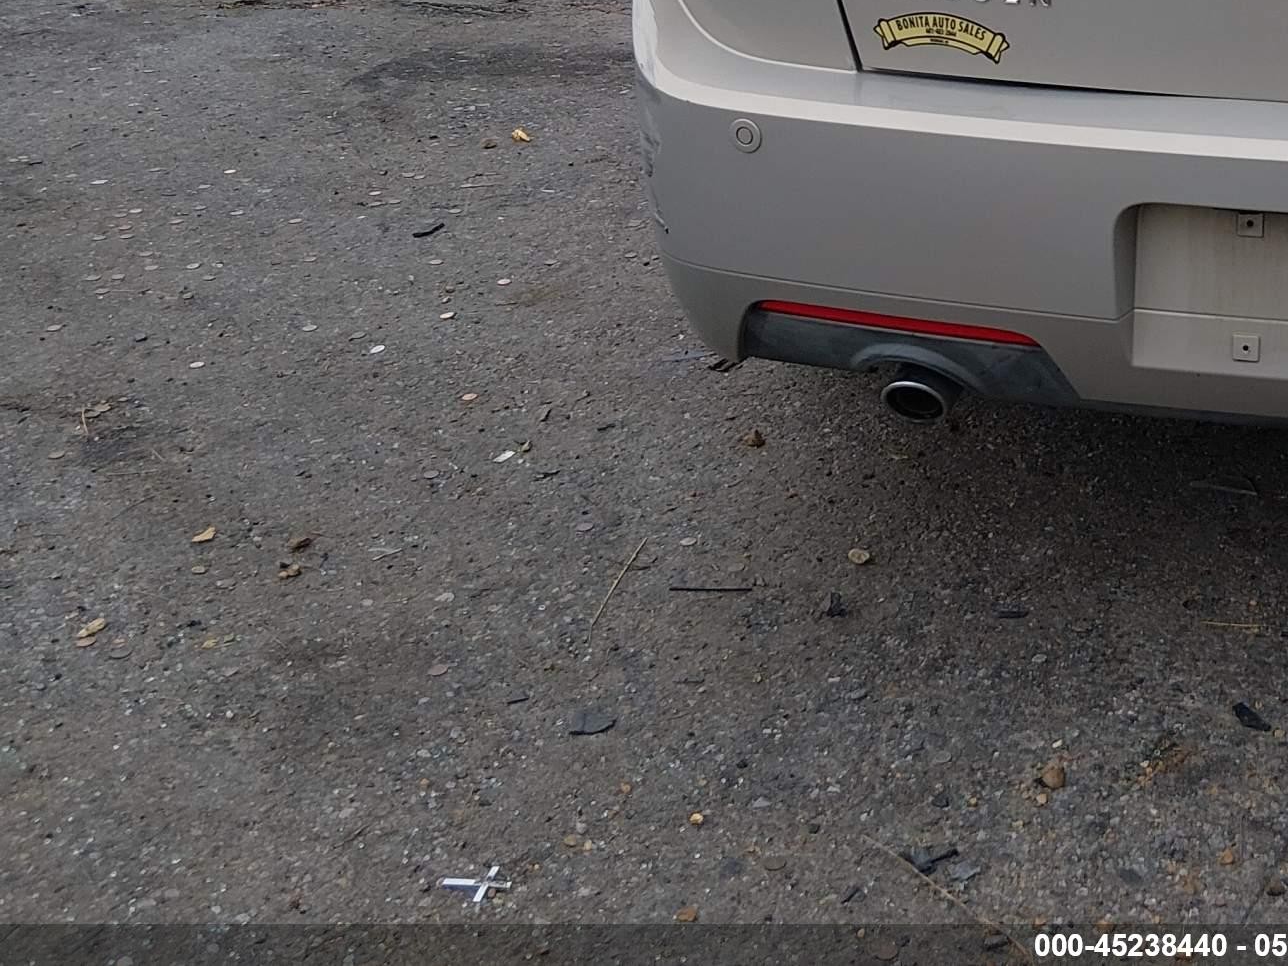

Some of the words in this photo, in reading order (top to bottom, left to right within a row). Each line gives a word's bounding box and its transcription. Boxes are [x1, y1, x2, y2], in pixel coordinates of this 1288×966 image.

[895, 16, 930, 31] BONITA
[932, 16, 957, 30] AUTO
[958, 21, 987, 41] SALES
